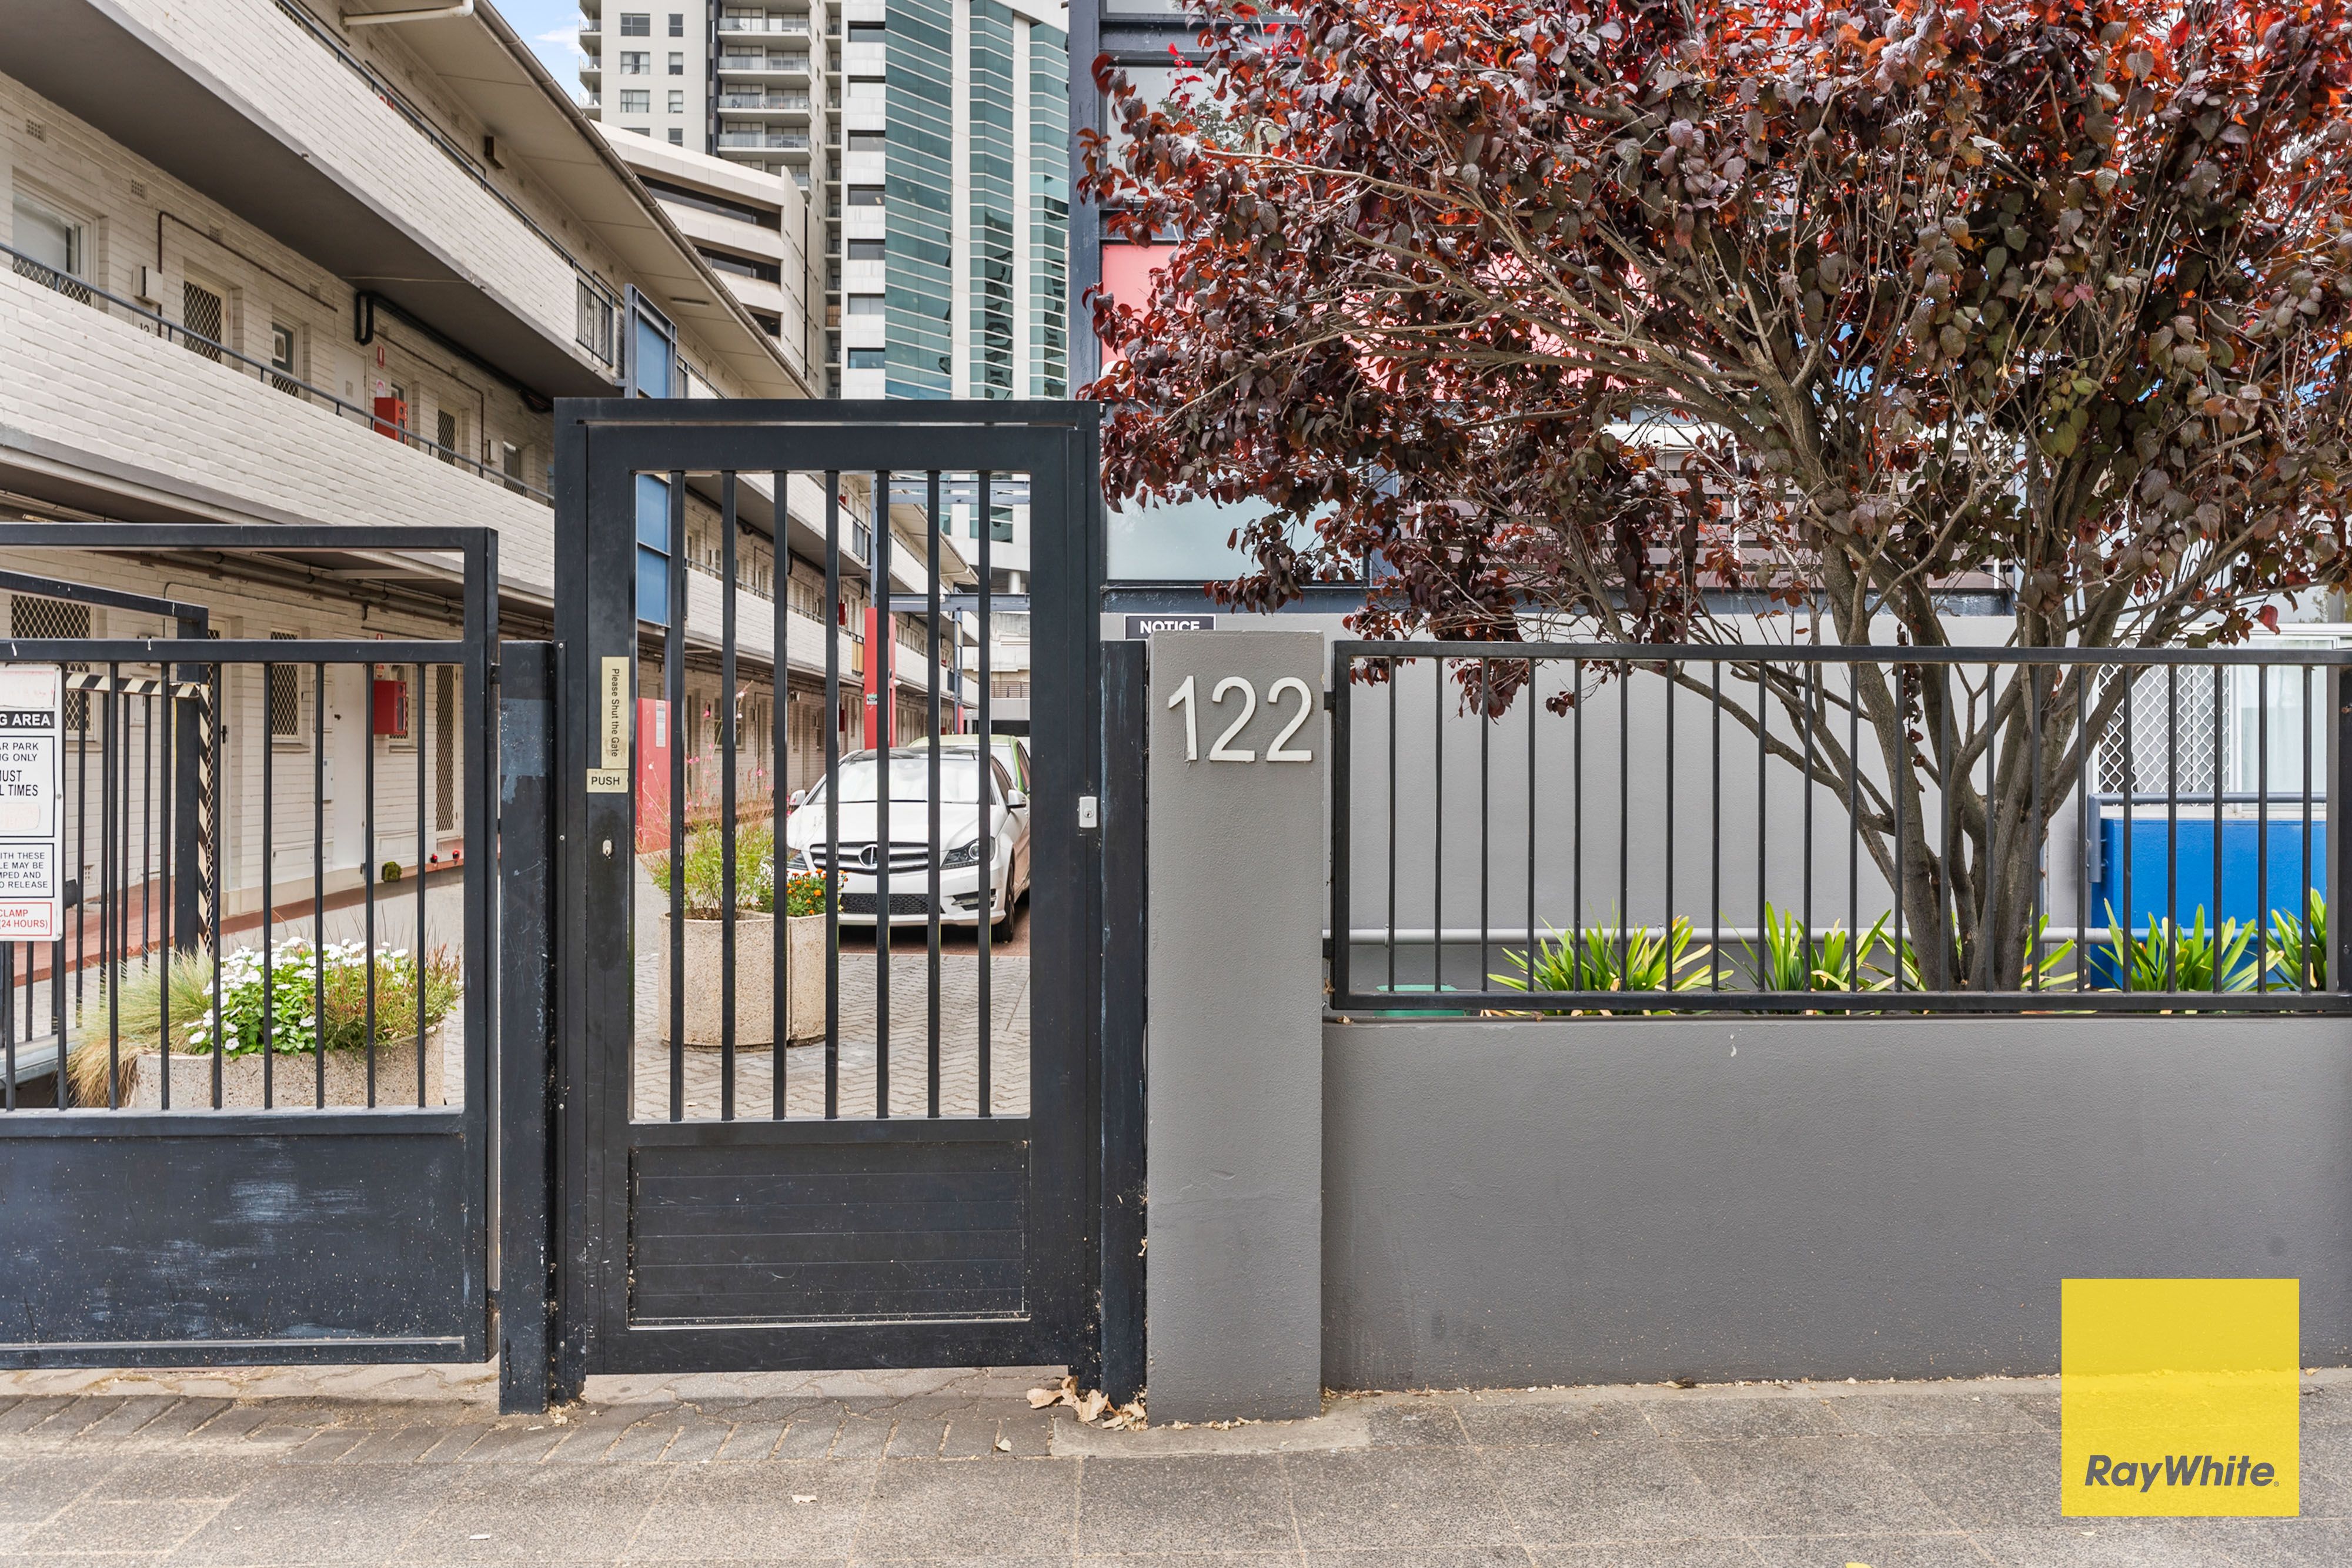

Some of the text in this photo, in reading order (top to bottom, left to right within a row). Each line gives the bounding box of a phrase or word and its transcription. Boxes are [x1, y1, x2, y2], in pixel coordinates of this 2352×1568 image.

[1140, 620, 1200, 634] NOTICE
[612, 668, 620, 697] Please
[612, 699, 620, 718] Shut
[12, 713, 51, 726] AREA
[1168, 675, 1312, 762] 122
[12, 743, 39, 751] PARK
[13, 753, 38, 762] ONLY
[0, 770, 22, 782] UST
[591, 777, 620, 785] PUSH
[8, 784, 38, 797] TIMES
[14, 920, 48, 930] HOURS)
